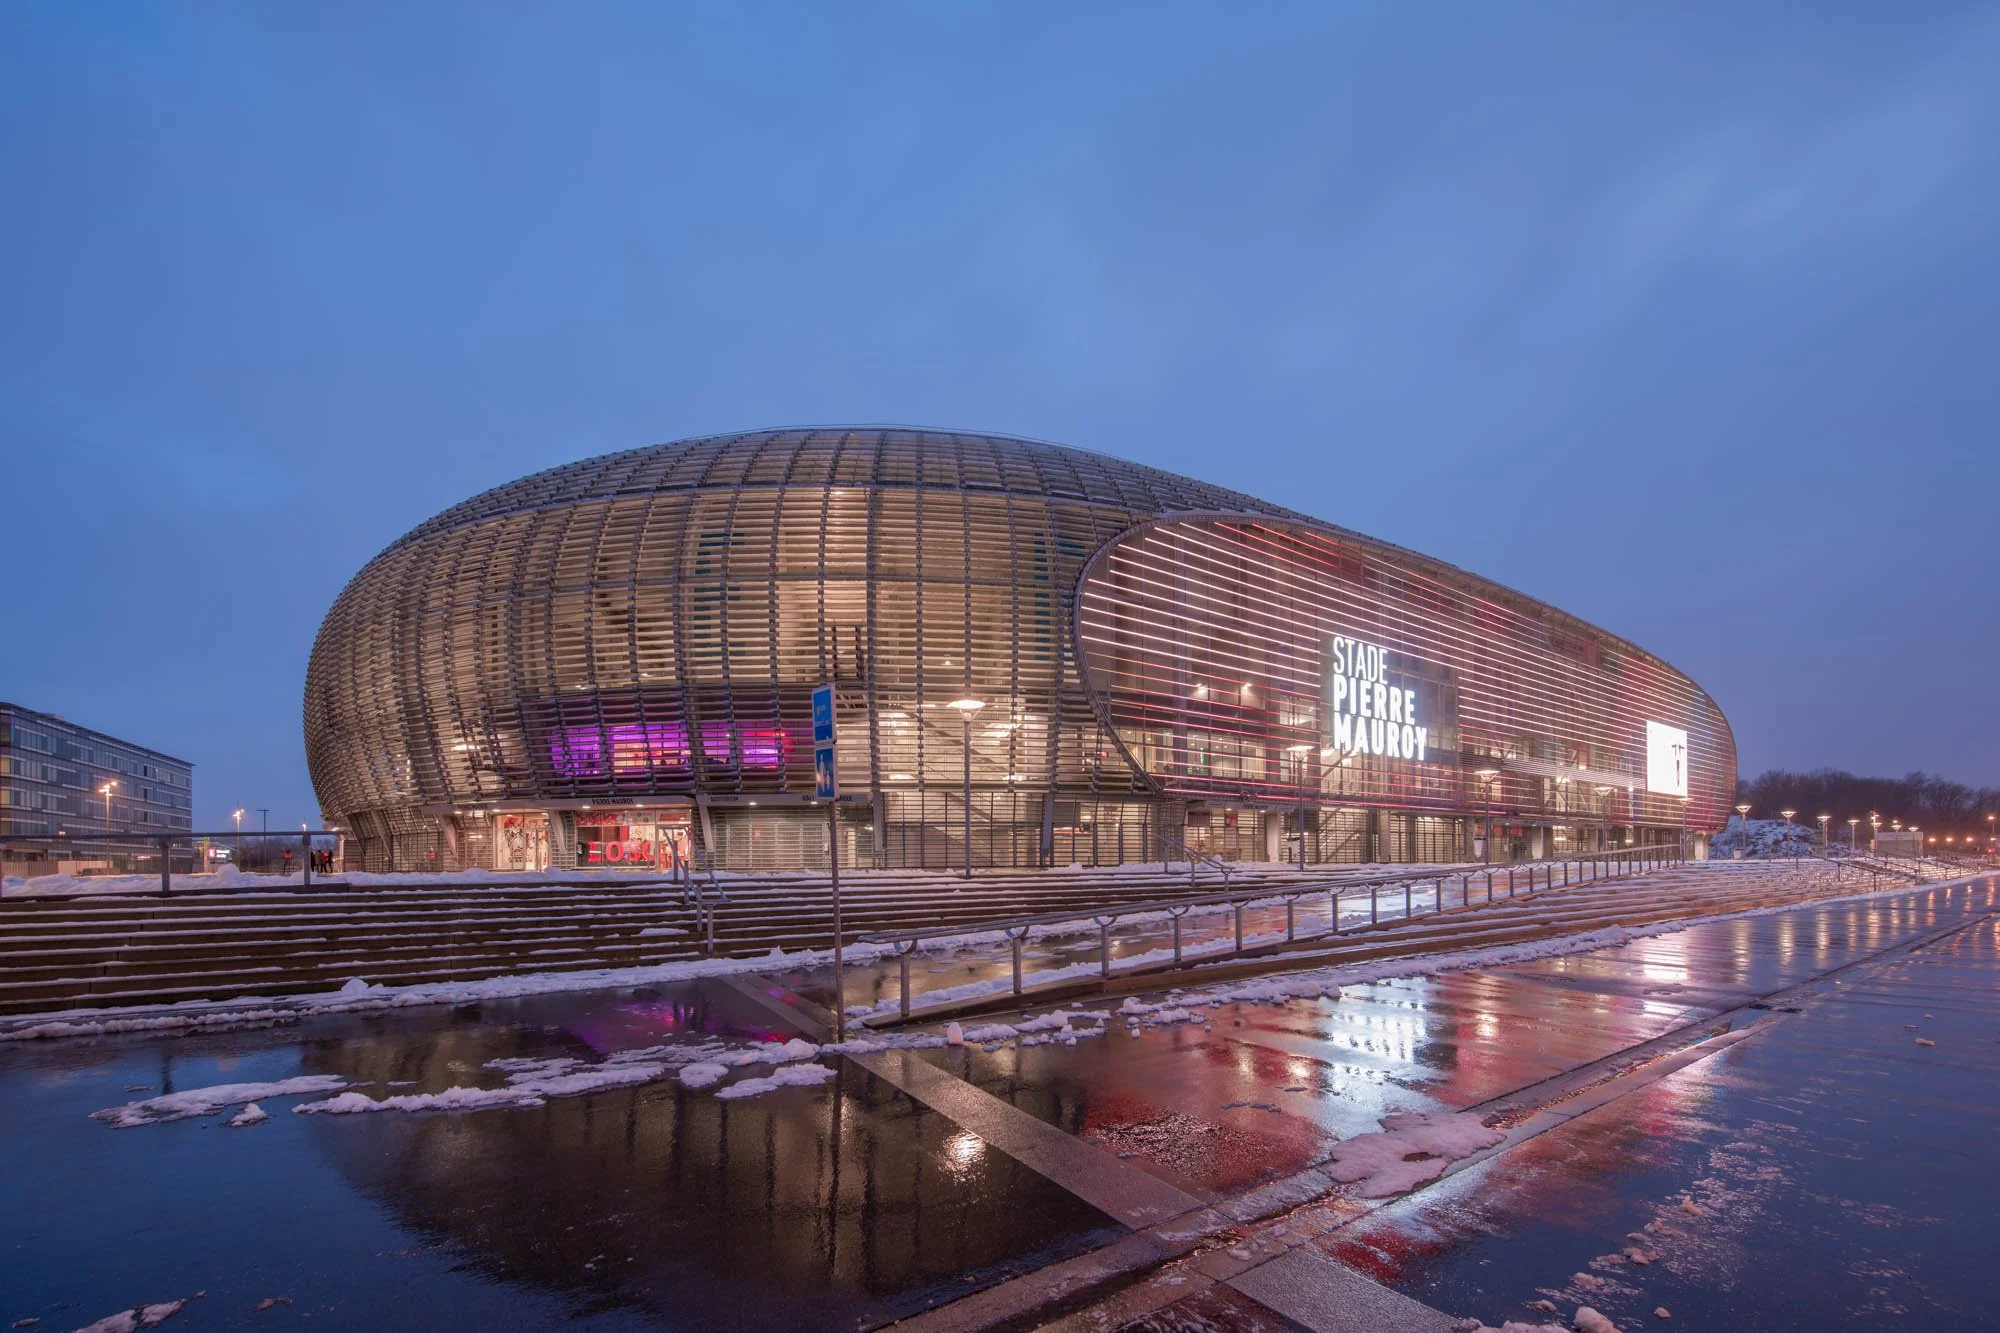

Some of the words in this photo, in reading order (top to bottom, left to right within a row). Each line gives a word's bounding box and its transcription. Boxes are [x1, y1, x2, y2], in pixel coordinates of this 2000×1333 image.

[1333, 636, 1388, 685] STADE
[1333, 674, 1415, 725] PIERRE
[1334, 711, 1427, 761] MAUROY
